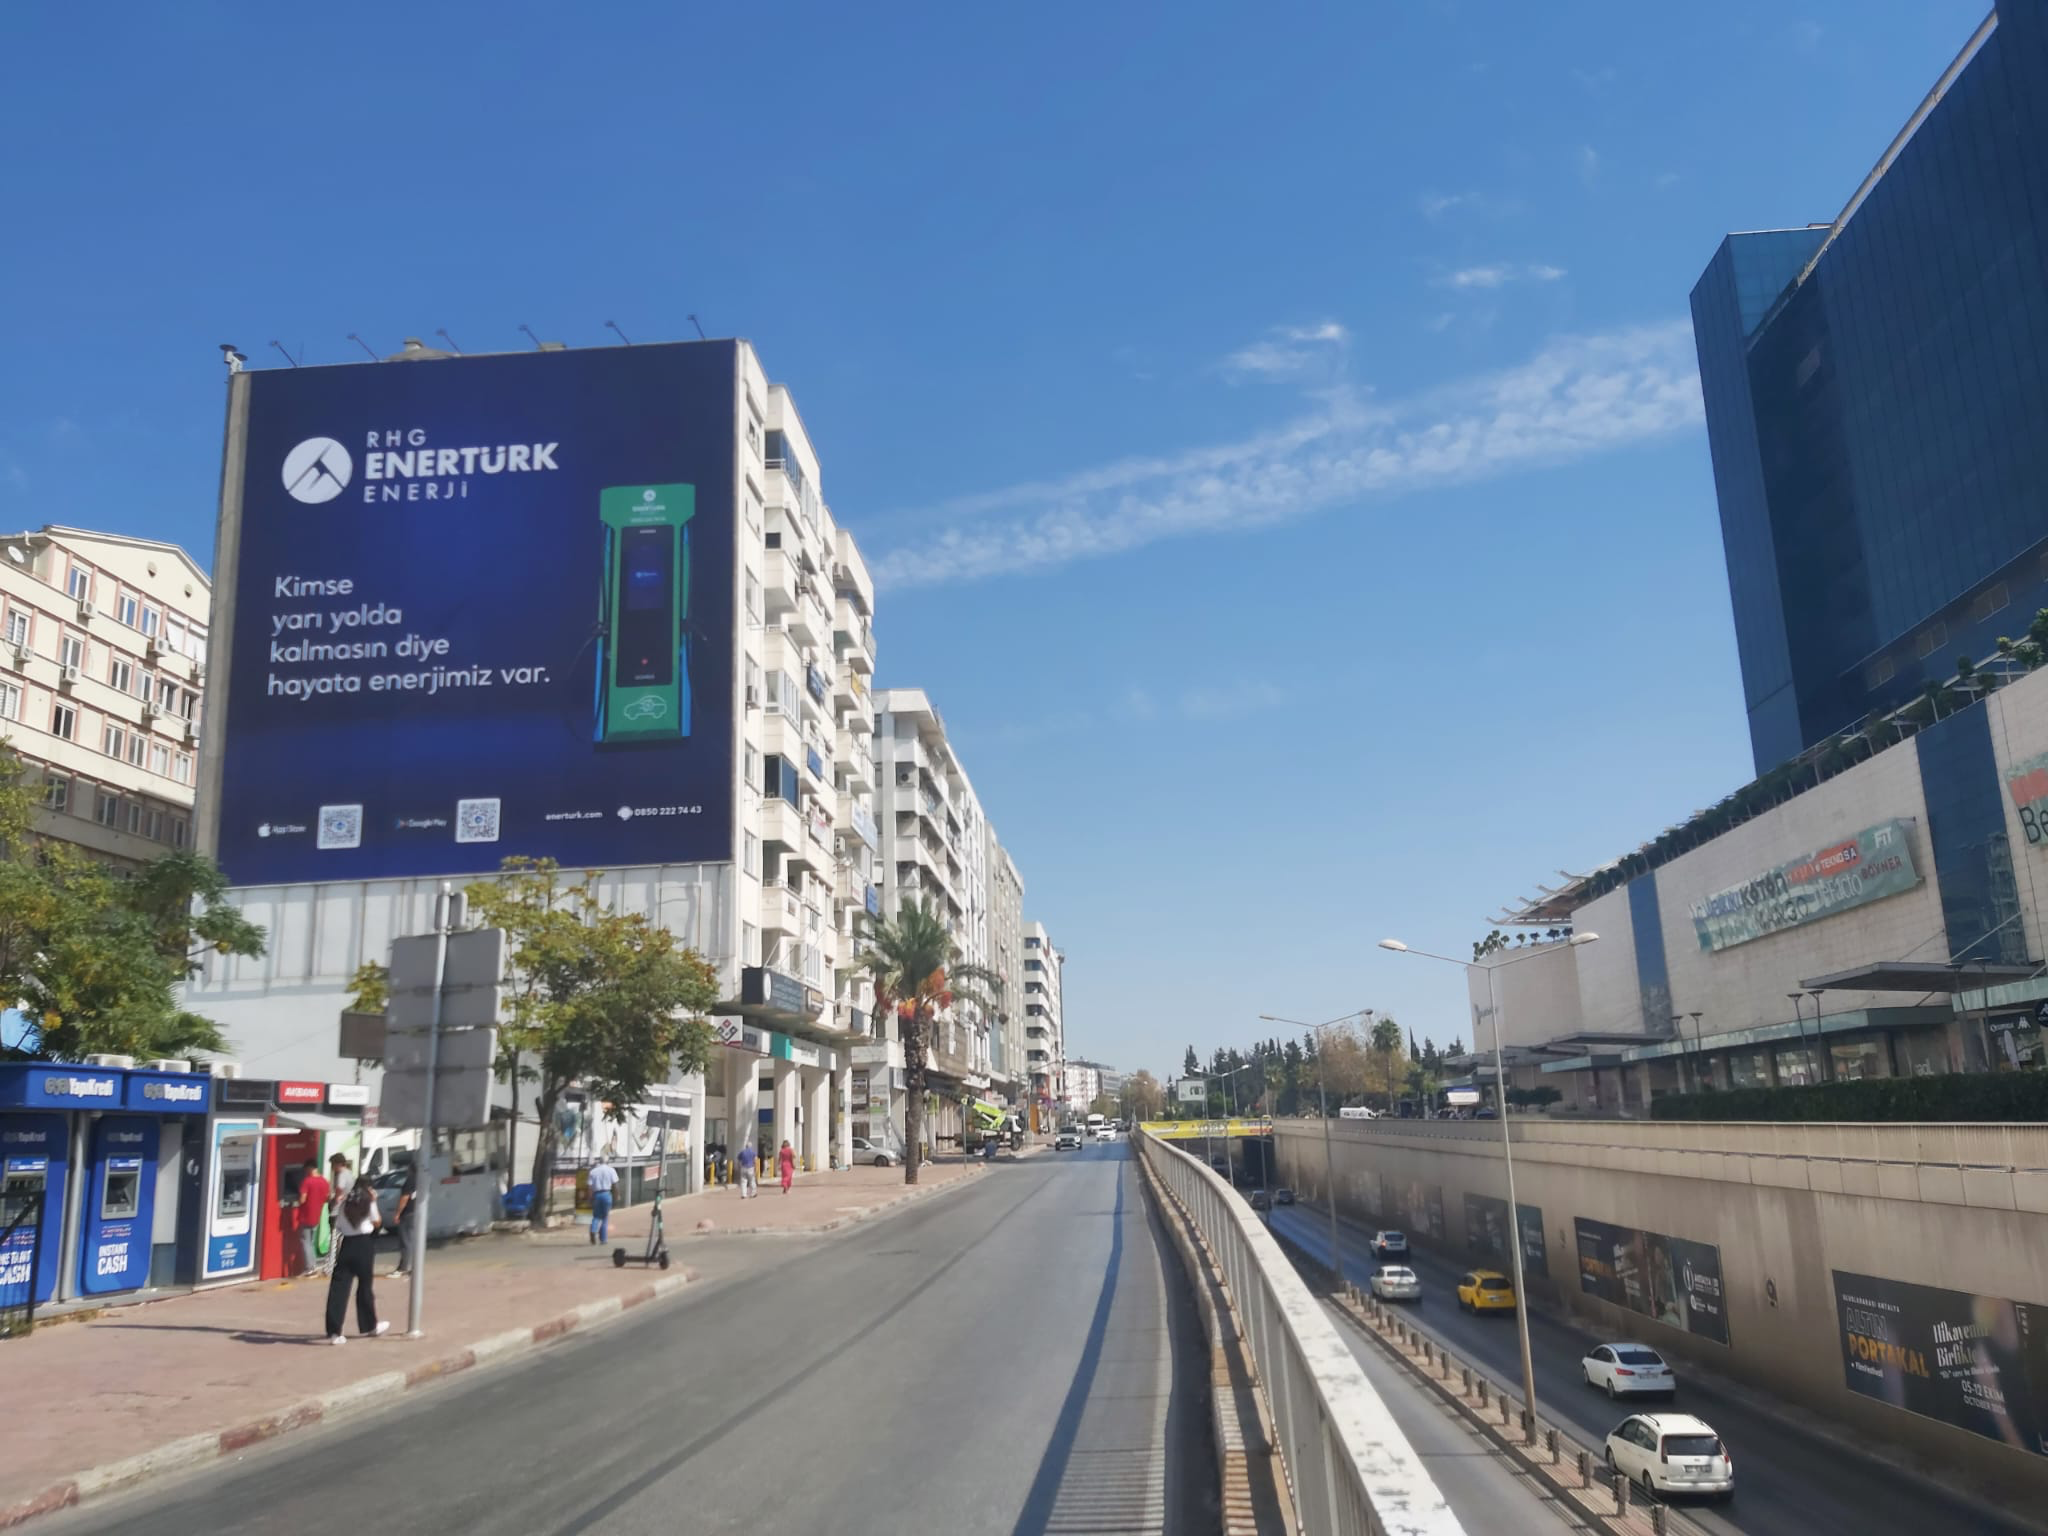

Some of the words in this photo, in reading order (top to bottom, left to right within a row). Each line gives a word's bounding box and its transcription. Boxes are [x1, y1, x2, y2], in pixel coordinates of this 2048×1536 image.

[366, 429, 426, 448] RHG
[365, 443, 559, 479] ENERTÜRK
[274, 576, 354, 598] Kimse
[272, 611, 322, 637] yarı
[329, 603, 402, 634] yolda
[270, 639, 388, 663] kalmasın
[395, 634, 450, 662] diye
[267, 673, 361, 701] hayata
[369, 665, 493, 695] enerjimiz
[501, 666, 550, 685] var.
[546, 812, 602, 820] enerturk.com
[660, 807, 677, 815] 222
[678, 806, 688, 814] 74
[98, 1242, 129, 1258] INSTANT
[97, 1255, 128, 1275] CASH
